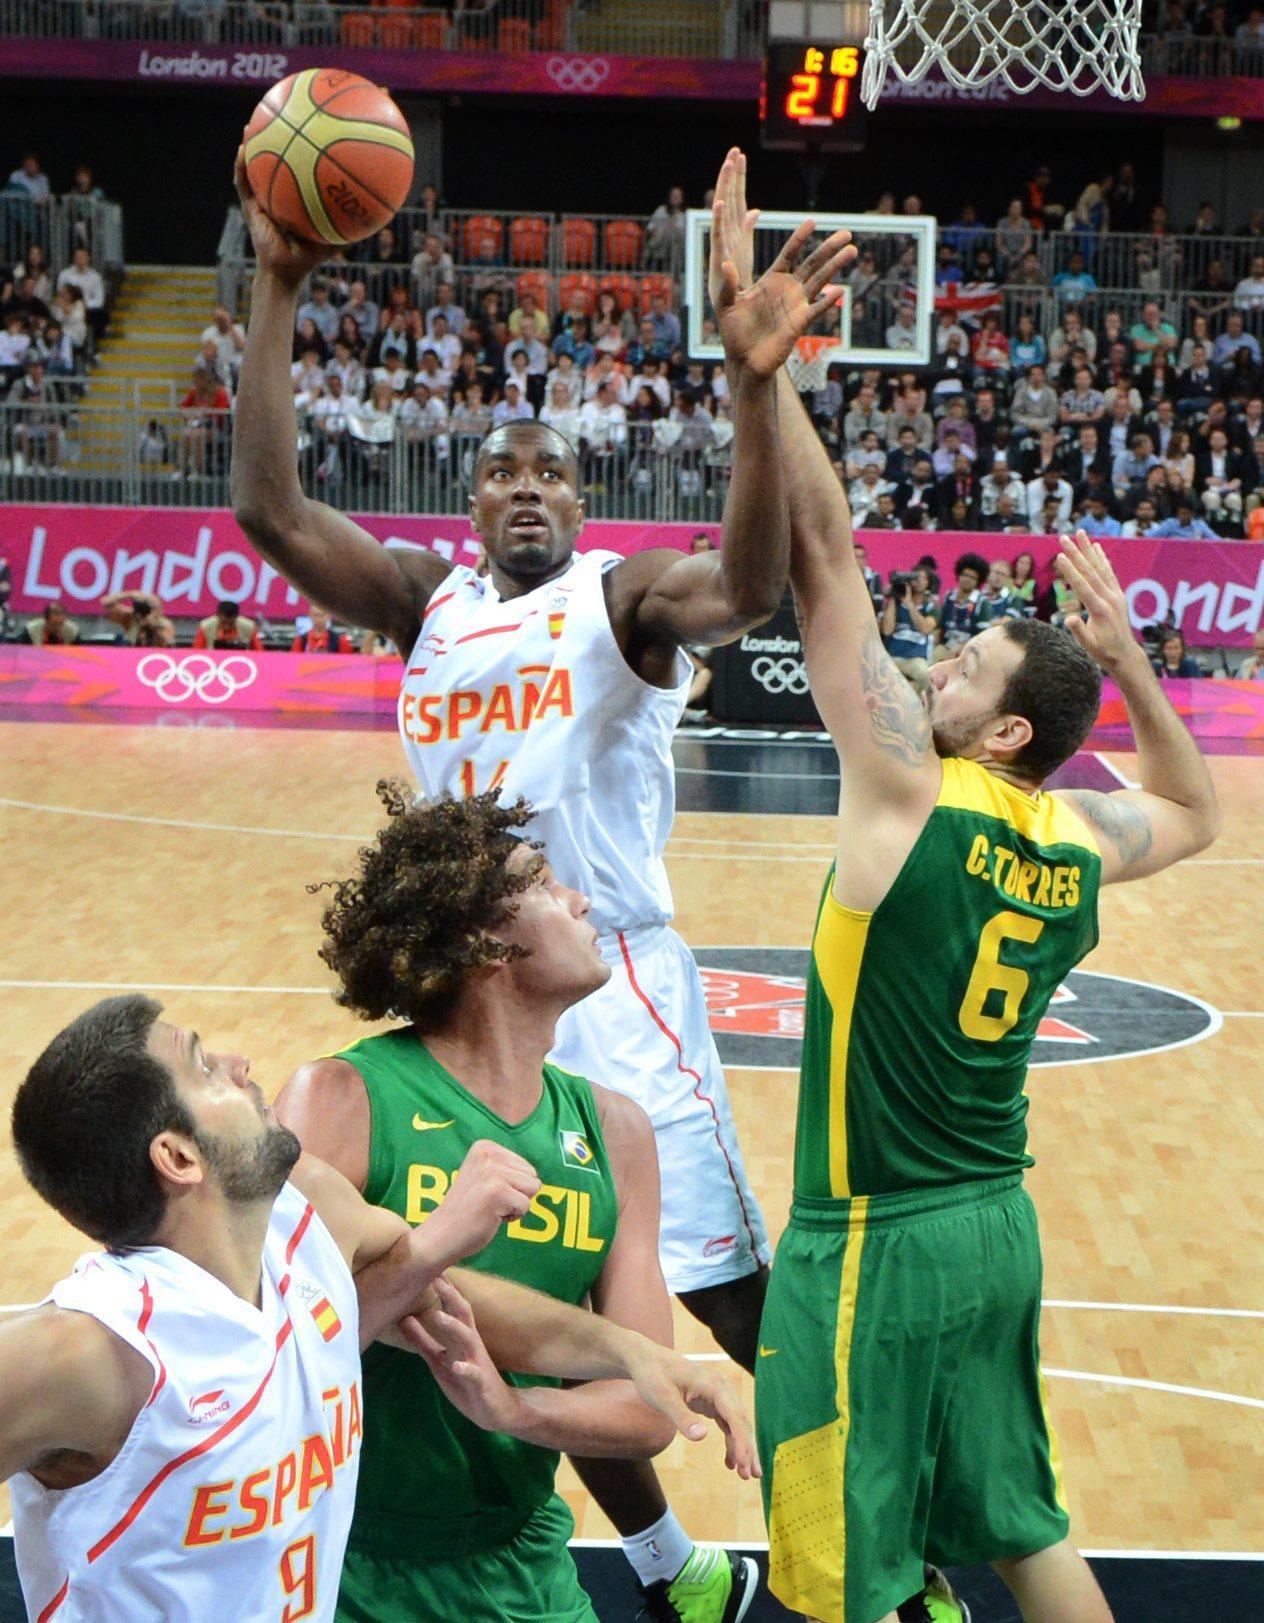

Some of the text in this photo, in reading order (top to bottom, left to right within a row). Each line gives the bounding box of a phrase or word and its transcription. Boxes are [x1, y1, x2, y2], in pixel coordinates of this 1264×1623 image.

[138, 51, 288, 78] London 2012
[786, 74, 848, 118] 21
[879, 79, 952, 99] ondon
[23, 526, 299, 606] London
[1125, 559, 1264, 633] ond
[740, 634, 801, 653] London
[402, 664, 575, 744] ESPAÑA
[965, 834, 1081, 908] C.TORRES
[958, 910, 1044, 1042] 6
[405, 1163, 605, 1253] BSIL
[279, 1533, 316, 1623] 9
